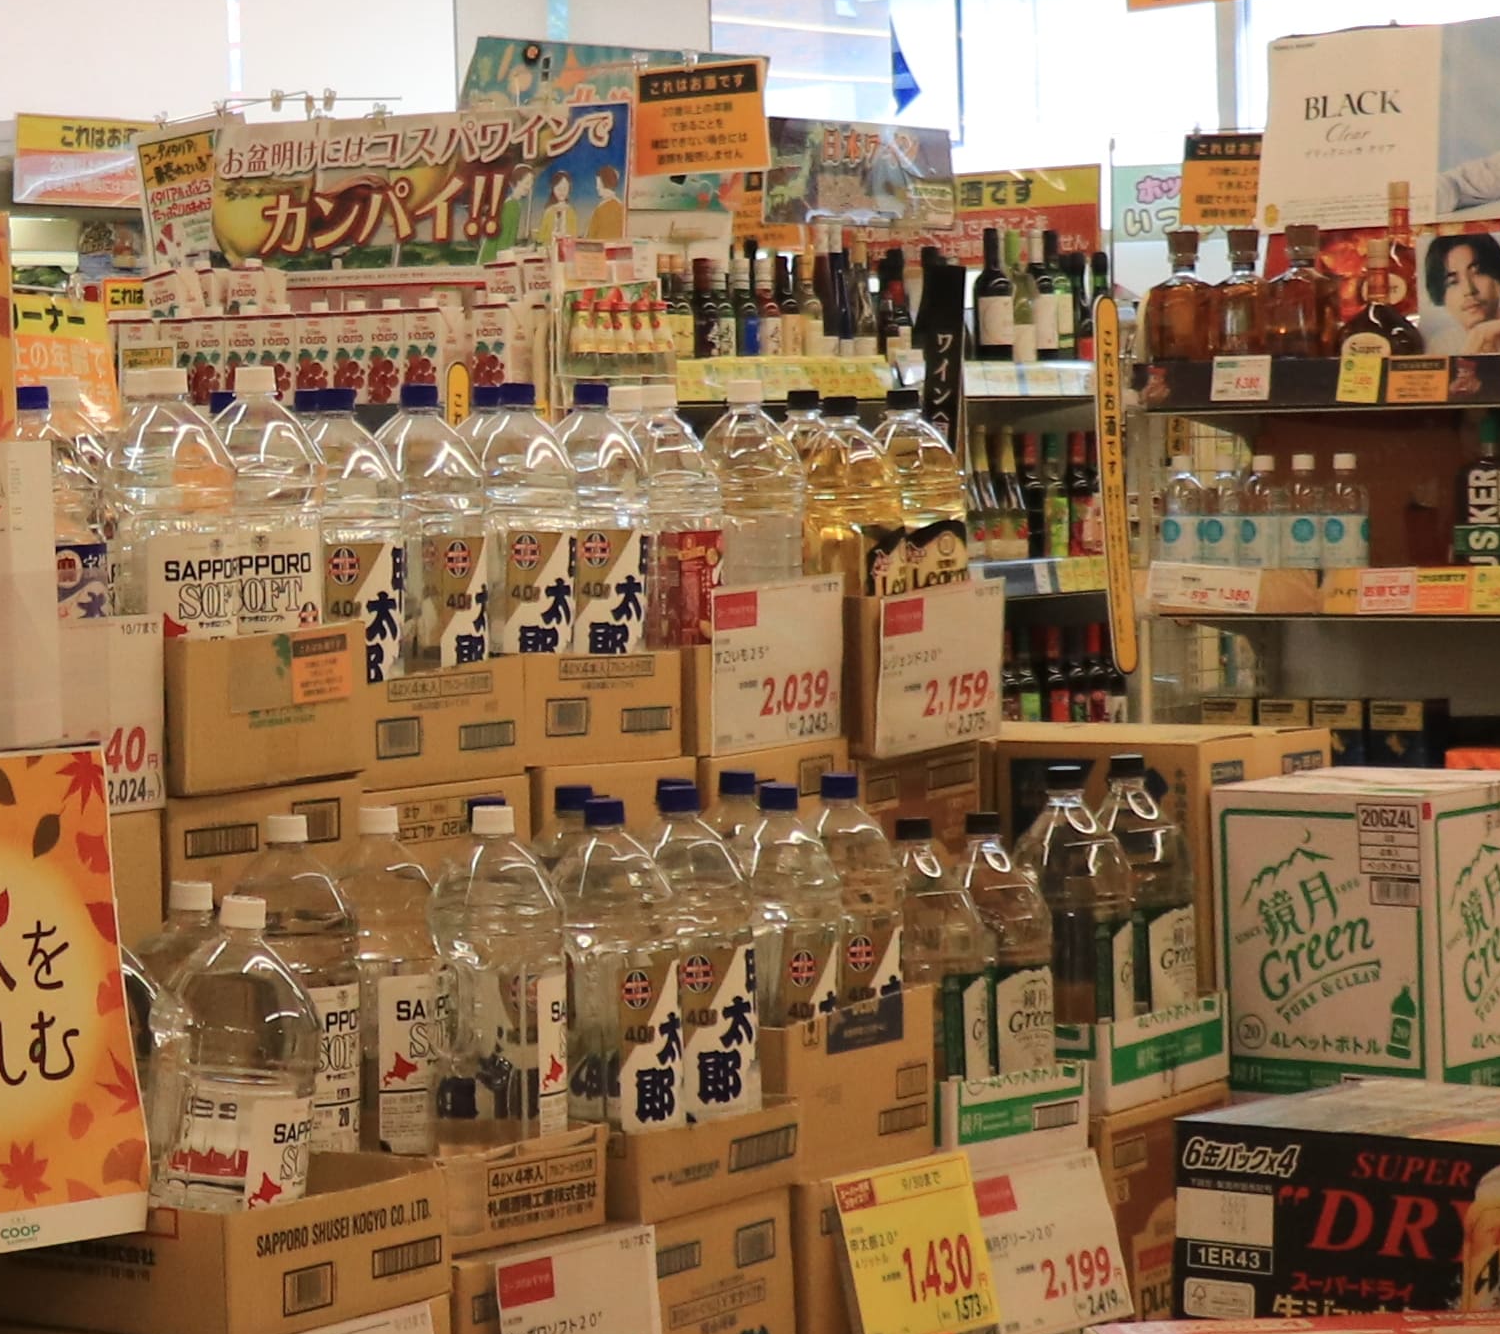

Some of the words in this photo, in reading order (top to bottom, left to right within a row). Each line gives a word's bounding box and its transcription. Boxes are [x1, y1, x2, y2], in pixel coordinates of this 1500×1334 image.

[648, 72, 744, 97] これはお酒です
[1304, 89, 1402, 123] BLACK
[221, 110, 614, 180] お盆明けにはコスパワインで
[821, 128, 920, 166] 日本ワイン
[760, 670, 829, 717] 2,039
[922, 670, 988, 717] 2,159
[1259, 871, 1339, 947] 鏡月
[1260, 916, 1374, 1002] Green
[1270, 1033, 1383, 1056] 4Lペットボトル
[1352, 1152, 1473, 1188] SUPER
[0, 1223, 41, 1242] COOP
[255, 1225, 309, 1257] SAPPORO
[313, 1217, 350, 1246] SHUSEI
[352, 1210, 387, 1237] KOGYO
[902, 1233, 972, 1304] 1,430
[1041, 1245, 1111, 1300] 2,199
[1198, 1246, 1260, 1269] 1ER43
[1086, 1289, 1118, 1316] 2,419
[1291, 1271, 1415, 1301] スーパードライ
[955, 1294, 981, 1322] 1,573
